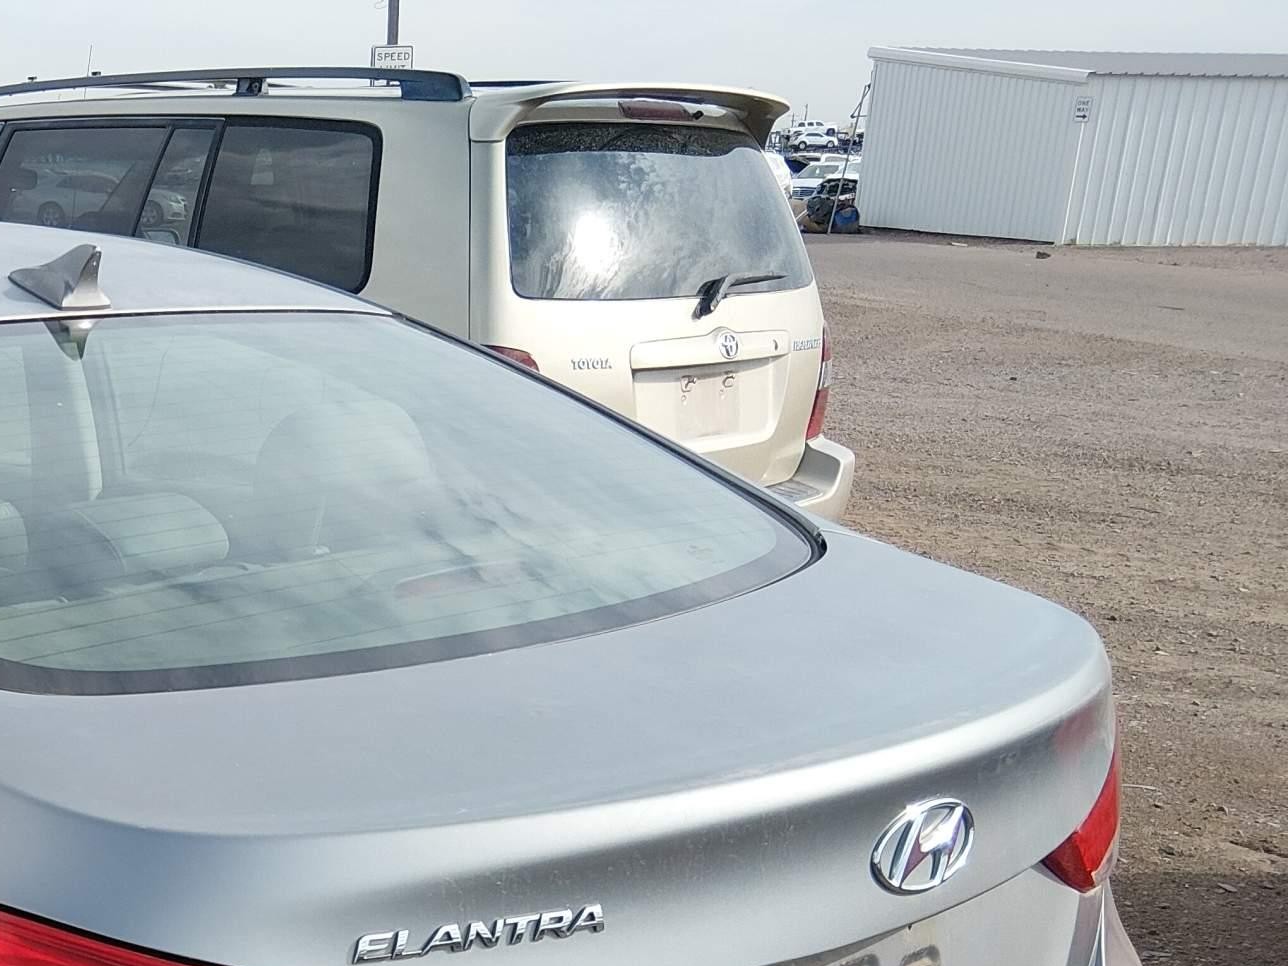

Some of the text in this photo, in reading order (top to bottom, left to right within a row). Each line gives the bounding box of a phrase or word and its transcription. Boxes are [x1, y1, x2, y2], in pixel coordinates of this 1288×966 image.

[377, 52, 410, 61] SPEED
[570, 358, 613, 370] TOYOTA
[348, 903, 605, 965] ELANTRA
